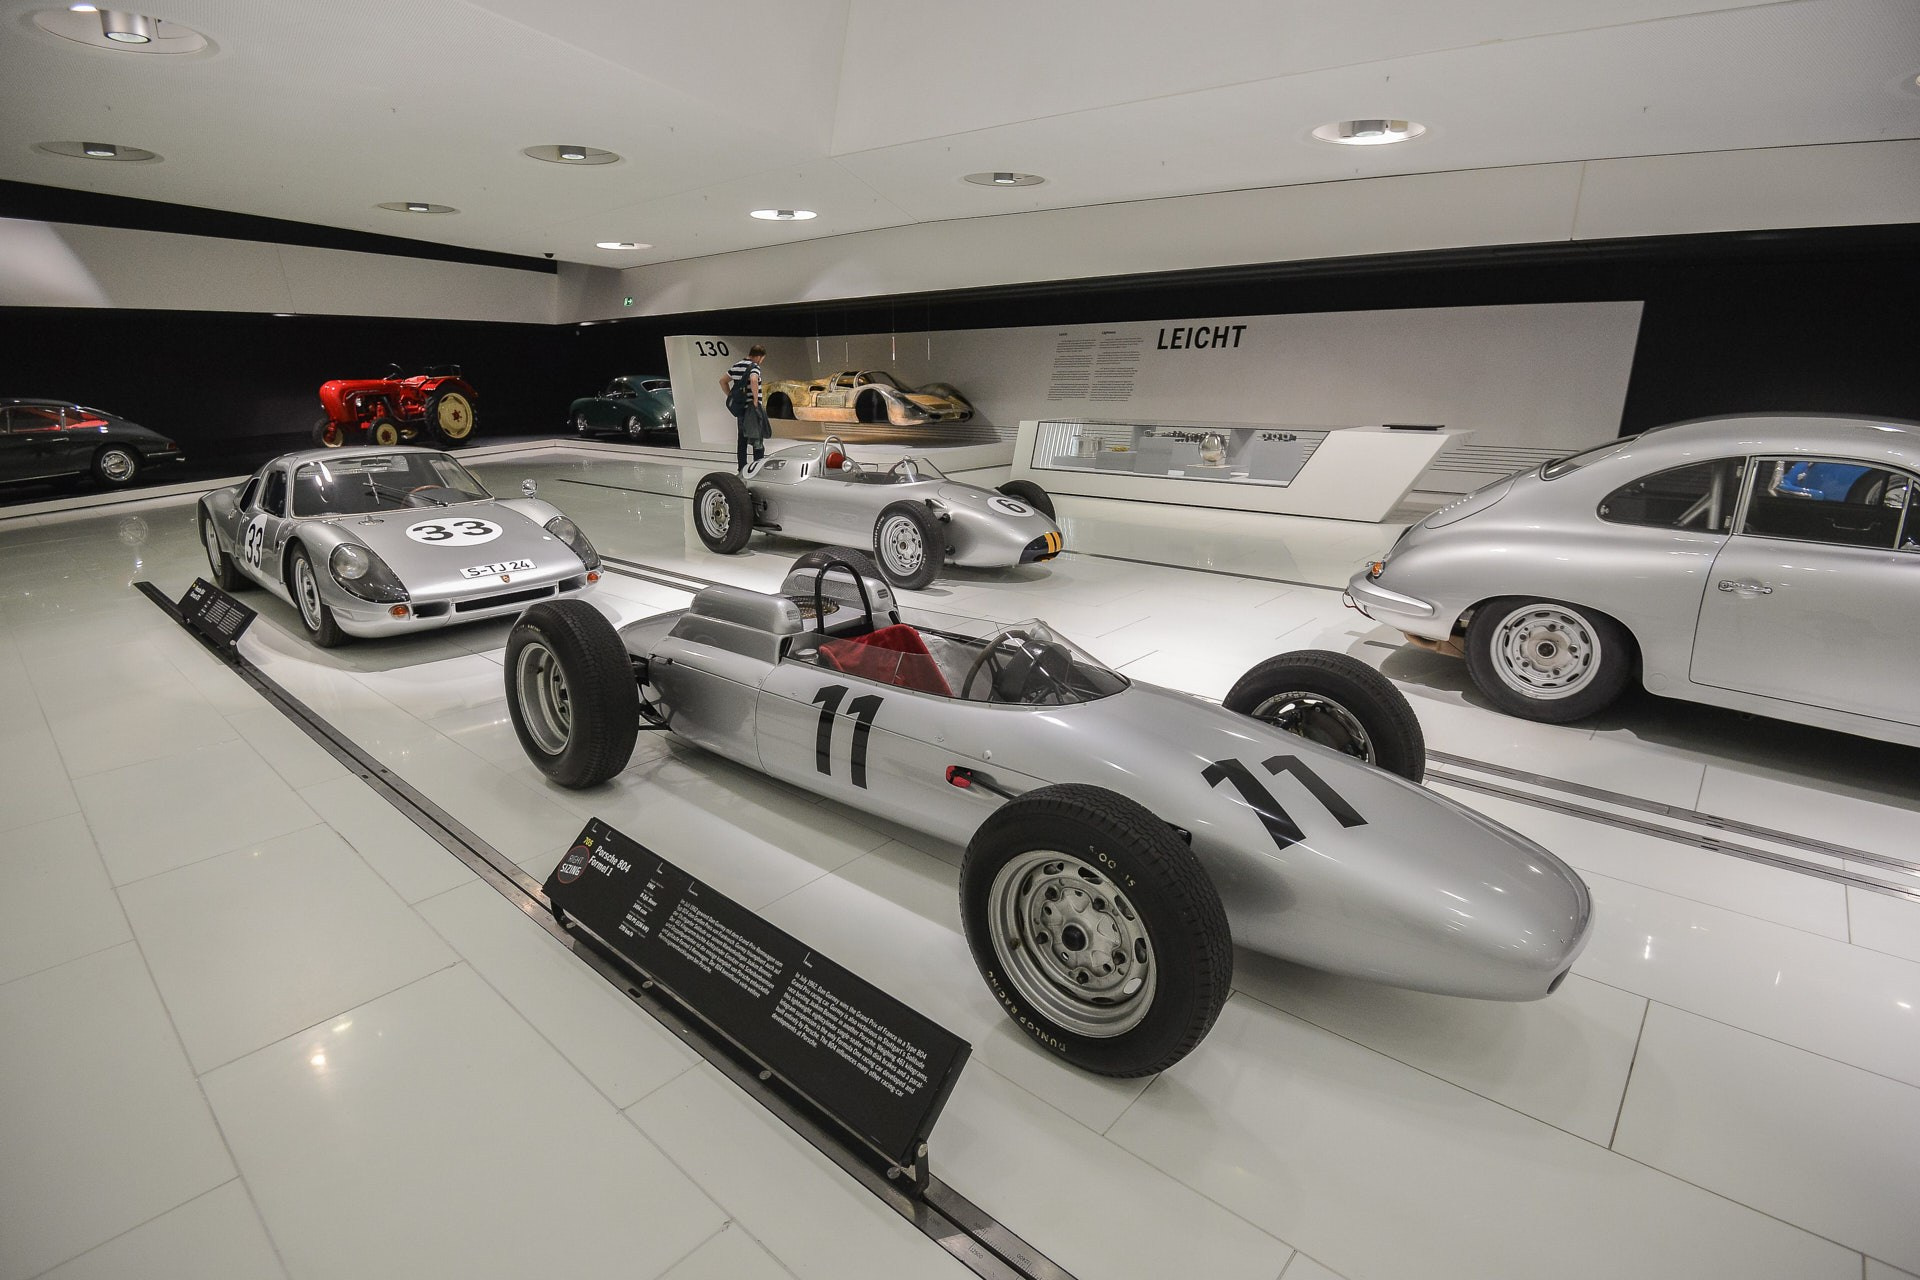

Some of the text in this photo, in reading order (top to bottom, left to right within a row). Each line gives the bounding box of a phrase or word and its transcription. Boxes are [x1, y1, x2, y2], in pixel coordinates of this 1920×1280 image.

[1157, 325, 1247, 350] LEICHT
[695, 341, 729, 357] 130
[996, 499, 1027, 514] 6
[412, 520, 494, 541] 33
[247, 524, 263, 569] 33
[467, 559, 531, 578] S-TJ 24
[811, 684, 884, 790] 11
[1201, 755, 1369, 850] 11
[560, 863, 582, 876] SIZING
[588, 855, 613, 877] Formel 1
[595, 845, 632, 873] Porsche 804
